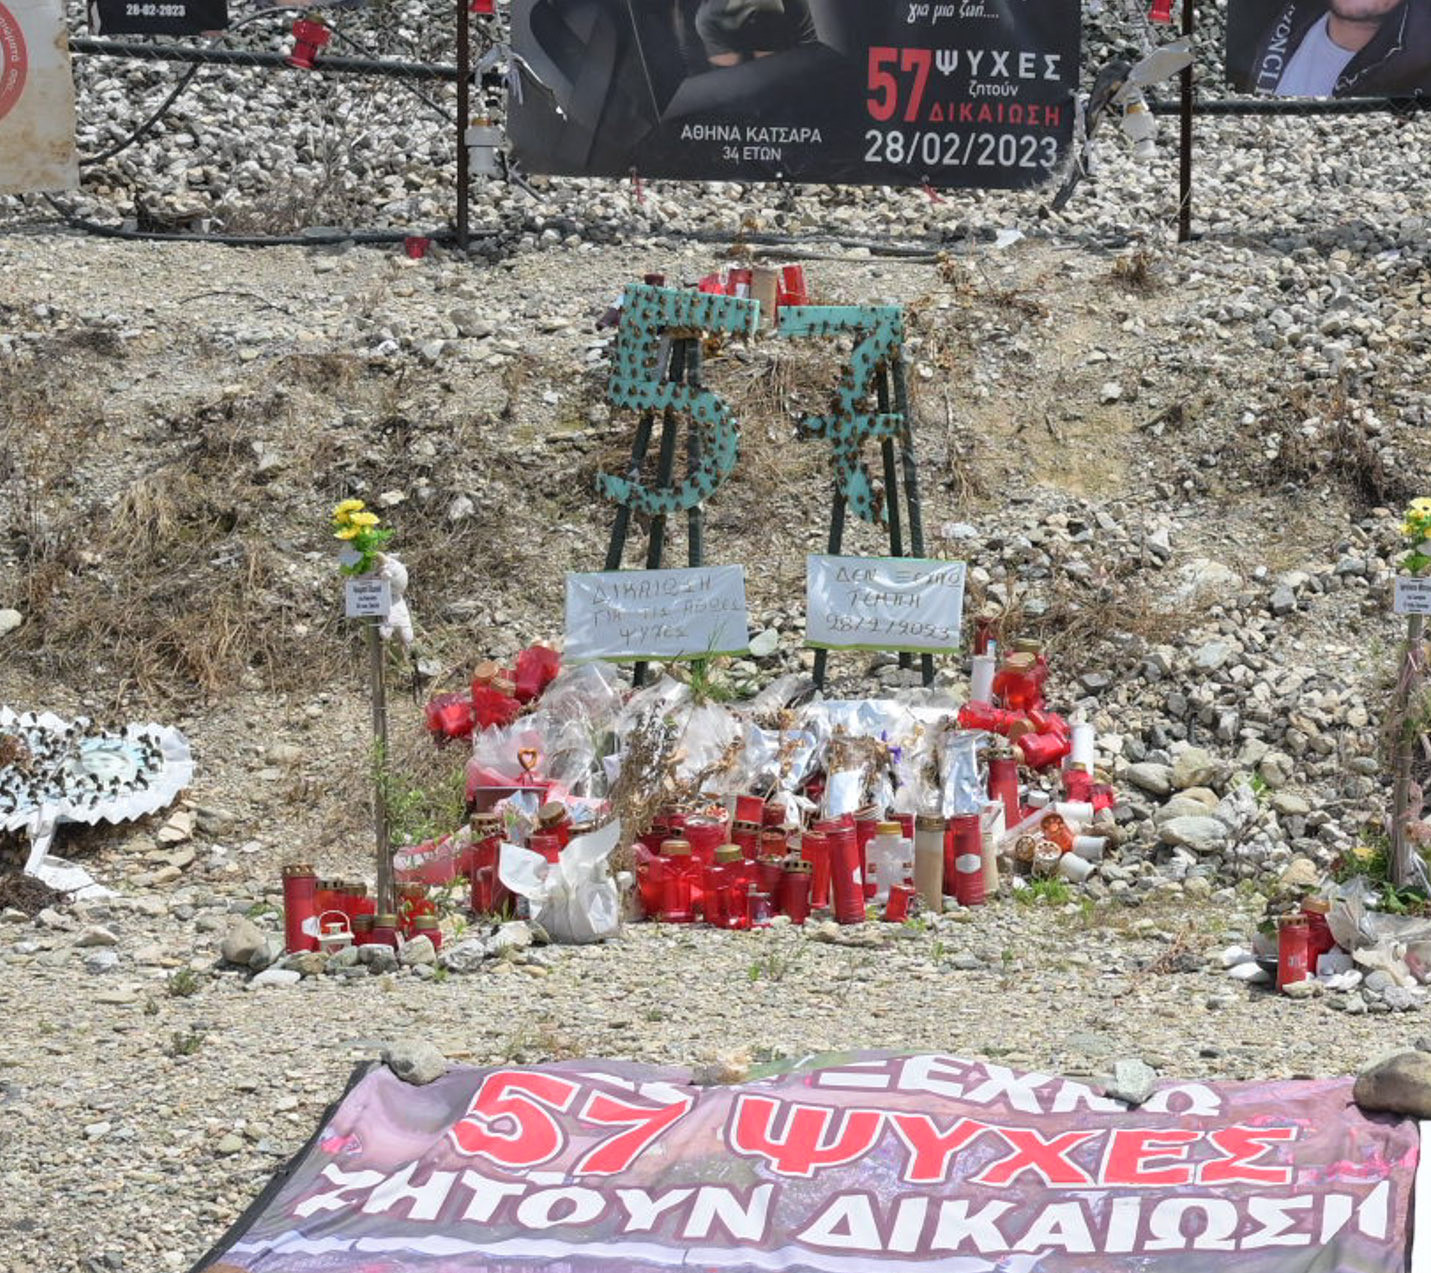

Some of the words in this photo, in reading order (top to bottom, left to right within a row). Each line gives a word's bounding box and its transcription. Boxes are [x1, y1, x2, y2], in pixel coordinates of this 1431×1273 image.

[867, 46, 933, 123] 57
[934, 48, 1063, 82] ΨΥΧΕΣ
[928, 101, 1063, 127] ΔΙΚΑΙΩΣΗ
[680, 124, 741, 143] ΑΘΗΝΑ
[746, 126, 822, 145] ΚΑΤΣΑΡΑ
[864, 129, 1059, 169] 28/02/2023
[743, 146, 782, 162] ΕΤΩΝ
[450, 1070, 696, 1177] 57
[730, 1092, 1300, 1188] ΨΥΧΕΣ
